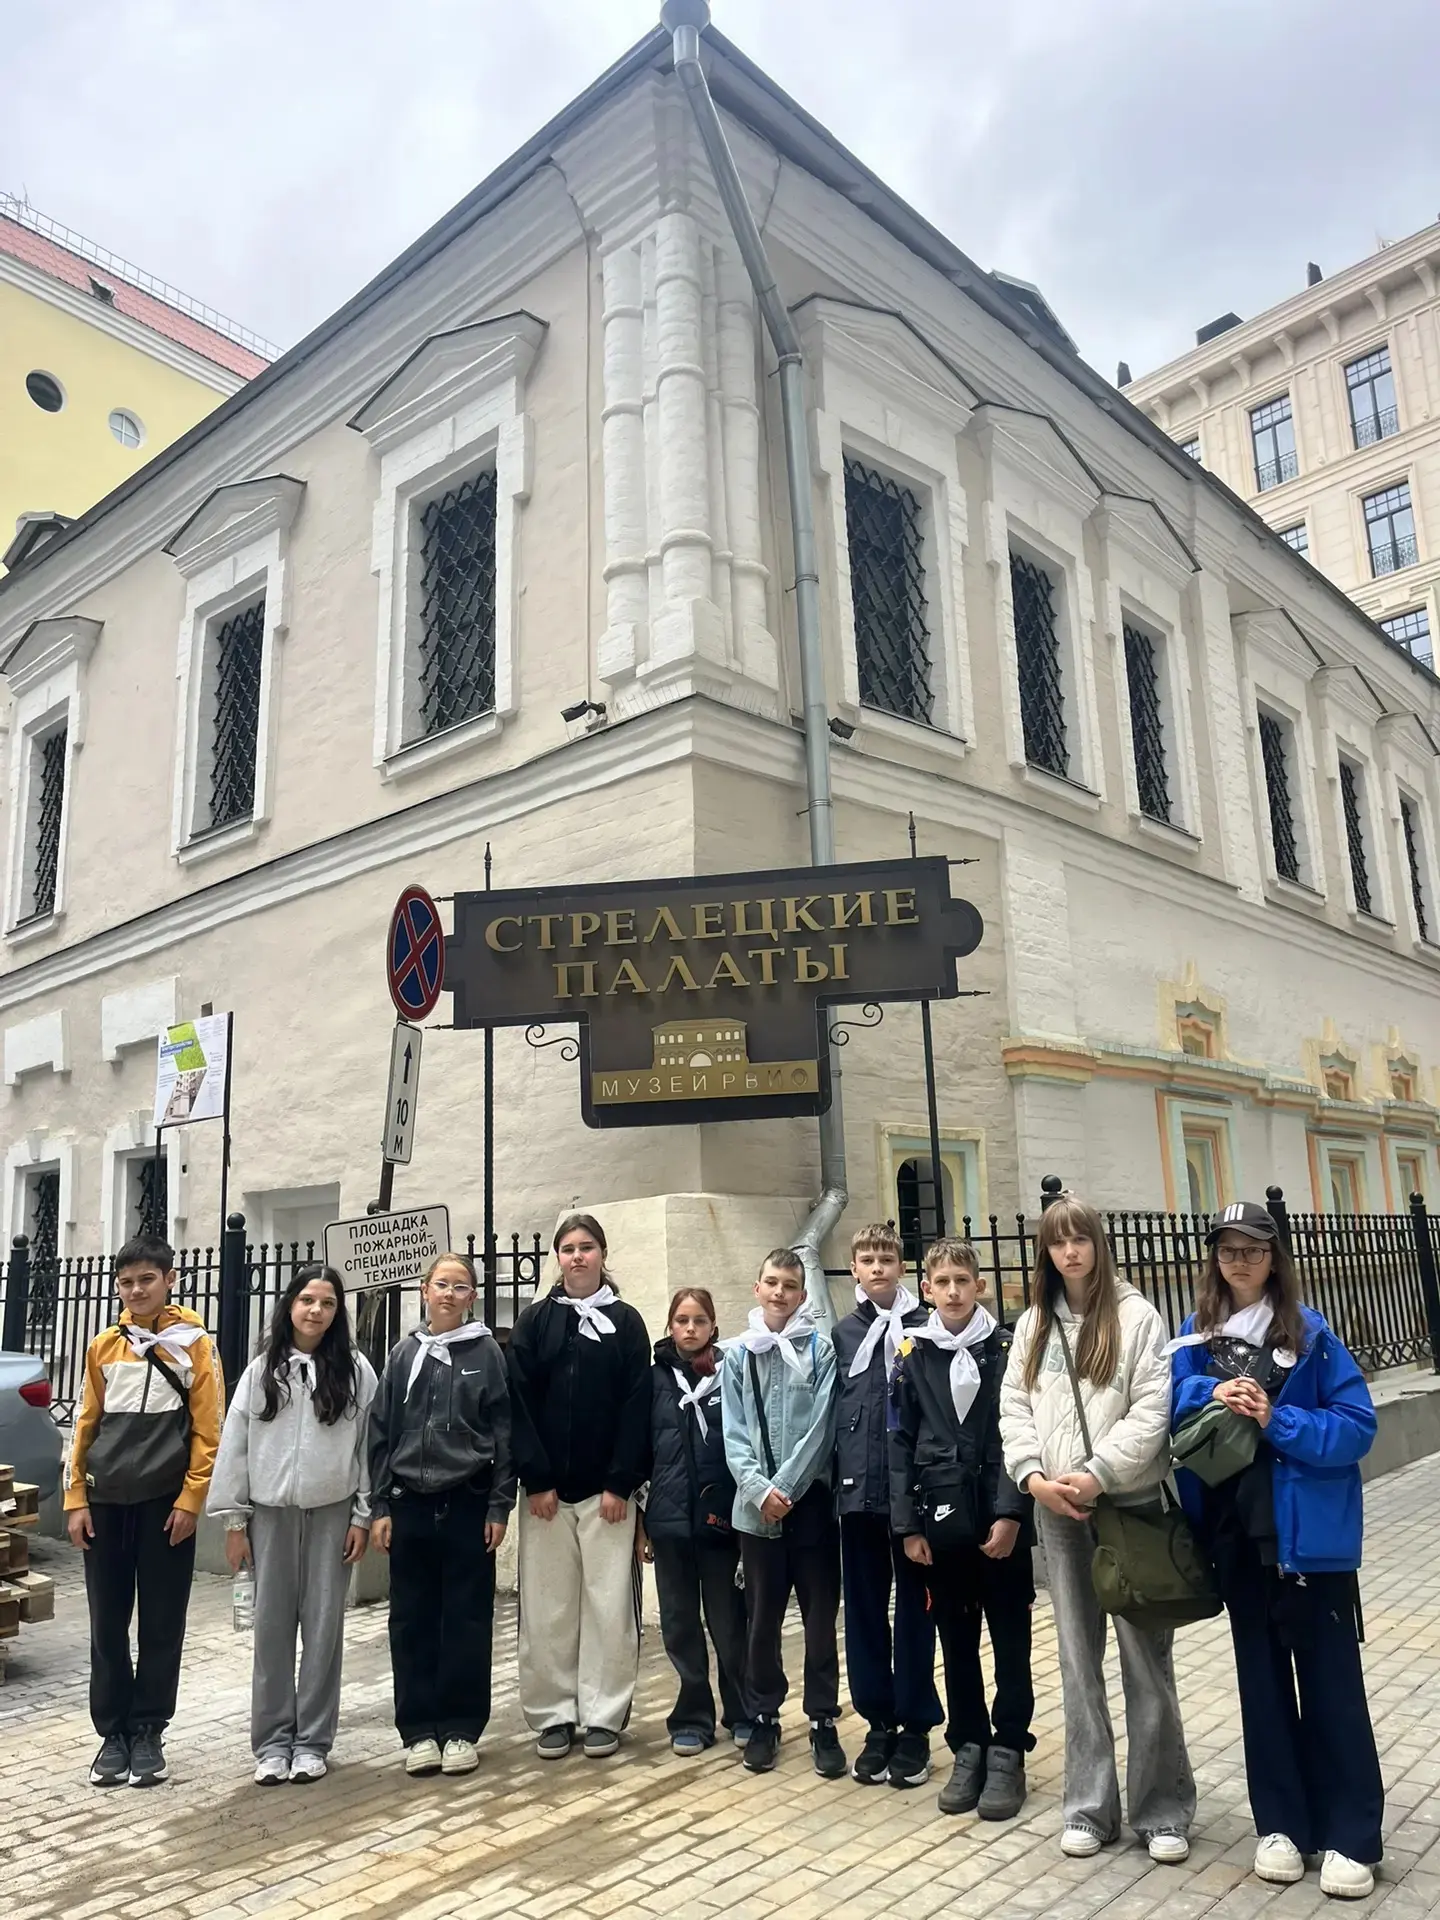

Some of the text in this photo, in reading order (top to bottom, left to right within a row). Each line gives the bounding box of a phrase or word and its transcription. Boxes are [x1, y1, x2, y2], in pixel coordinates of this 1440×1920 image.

[484, 887, 921, 953] СТРЕЛЕЦКИЕ
[552, 943, 851, 1000] ПАЛАТЫ
[601, 1067, 809, 1098] МУЗЕЙ РВИО
[396, 1098, 409, 1127] 10
[349, 1214, 429, 1240] ПЛОЩАДКА
[344, 1241, 438, 1272] СПЕЦИАЛЬНОЙ
[354, 1229, 434, 1256] ПОЖАРНОЙ-
[364, 1261, 423, 1284] ТЕХНИКИ
